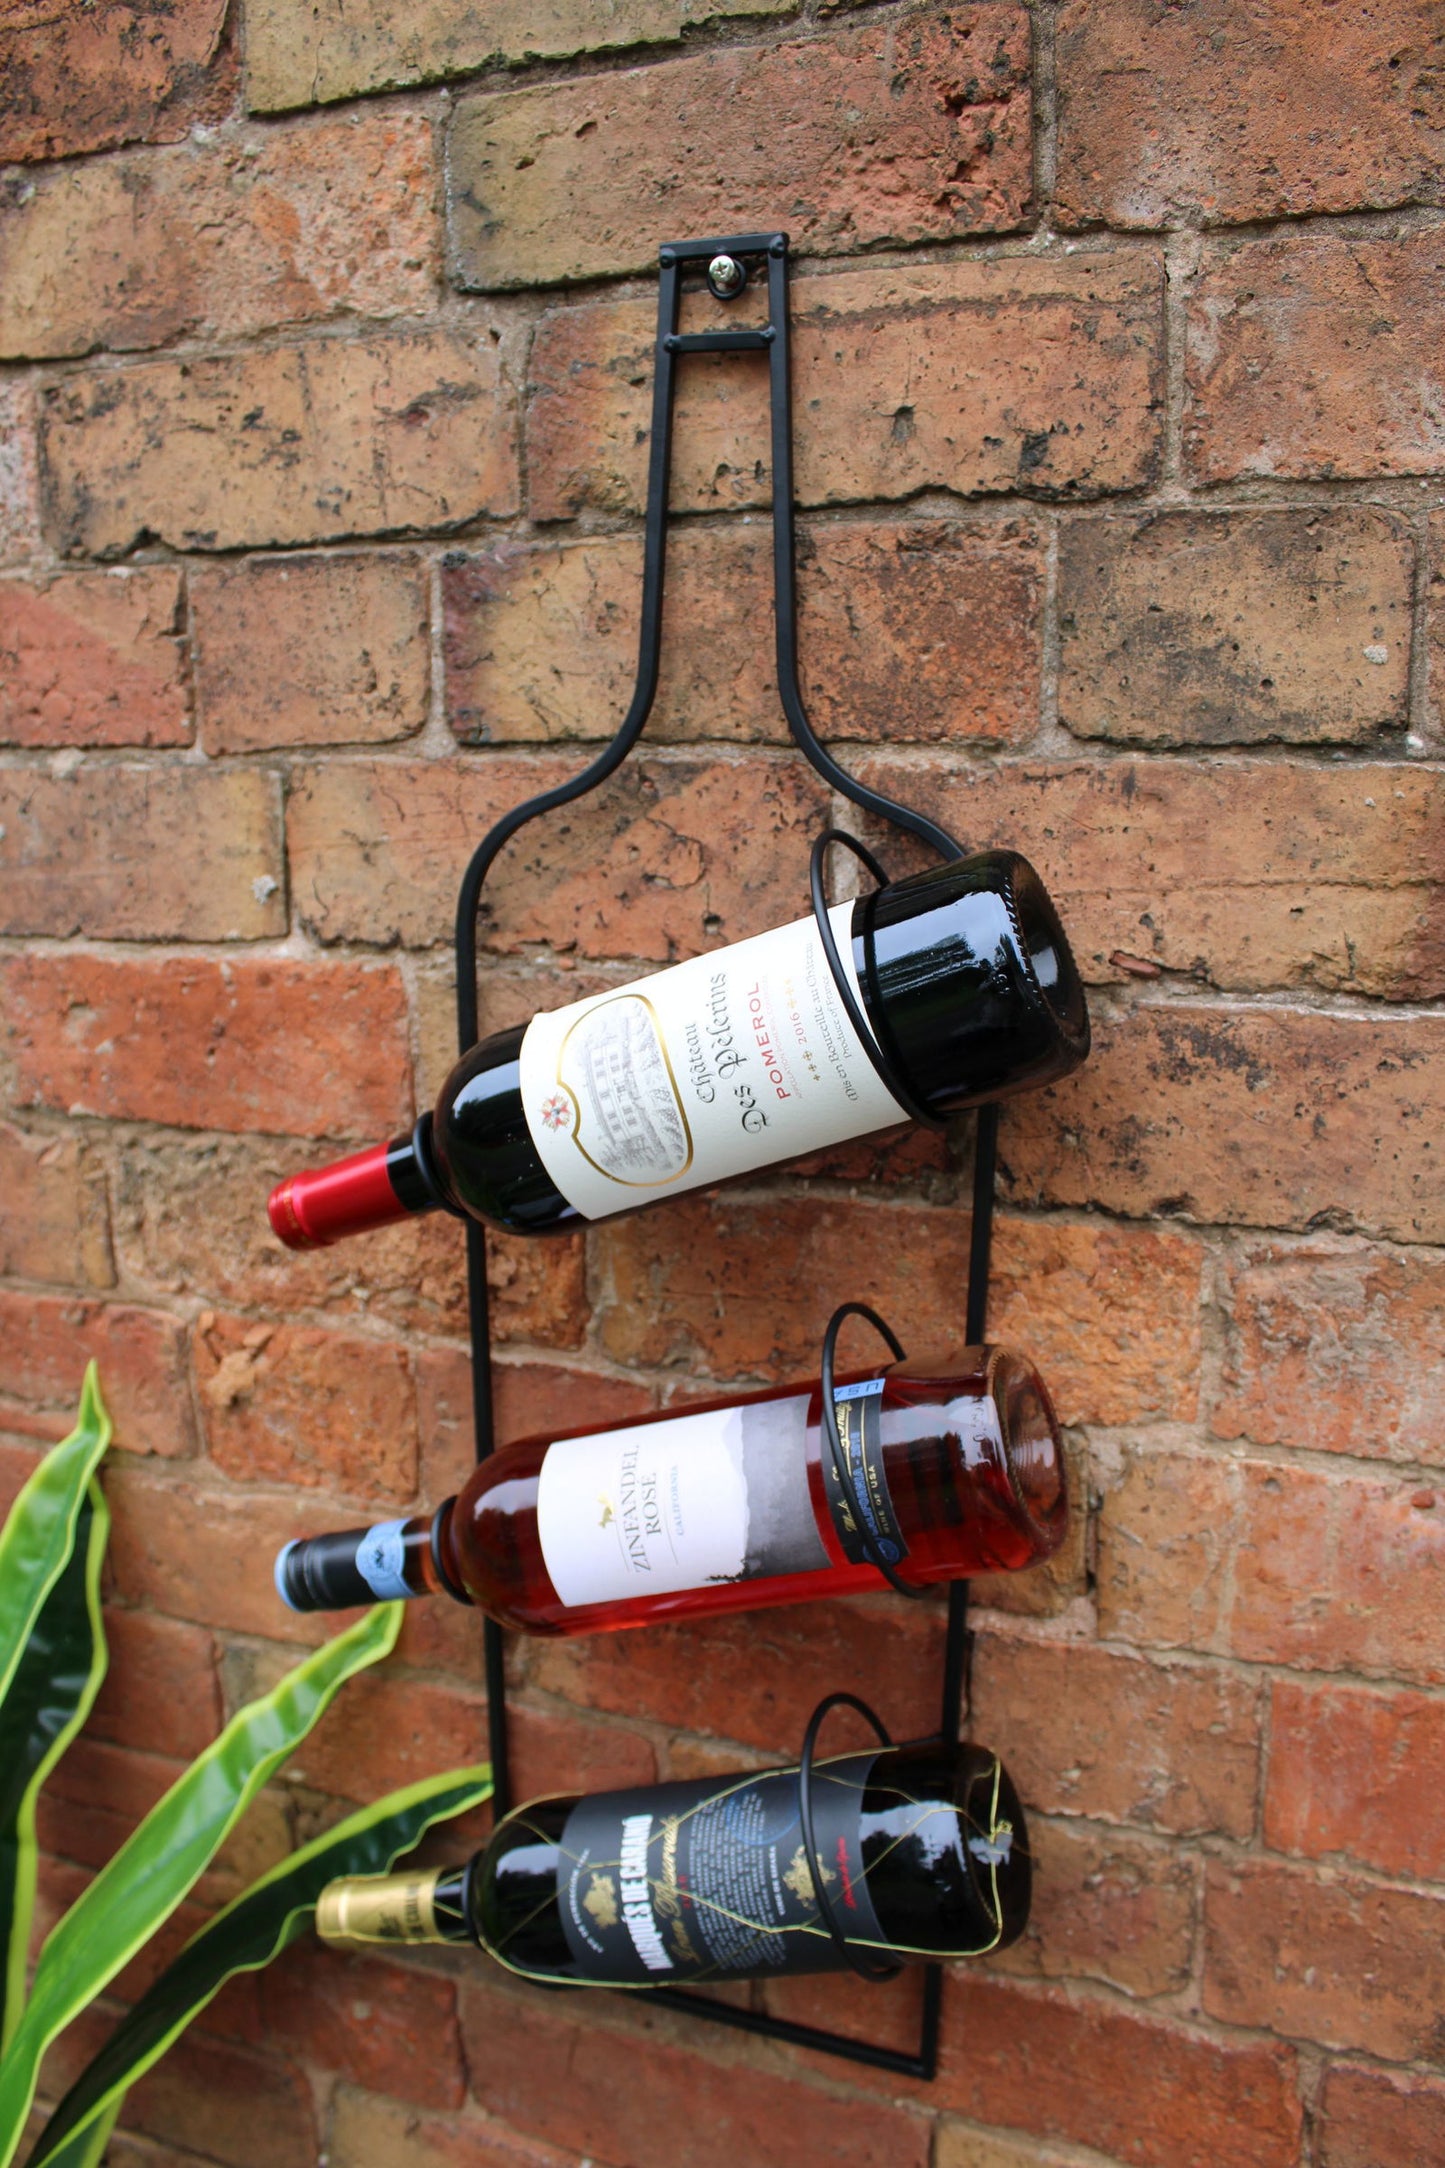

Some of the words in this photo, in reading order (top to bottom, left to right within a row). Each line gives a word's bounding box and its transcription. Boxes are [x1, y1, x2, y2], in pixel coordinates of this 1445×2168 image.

[822, 975, 834, 1006] France
[789, 1012, 808, 1045] 2016
[829, 1007, 839, 1018] of
[747, 982, 791, 1100] POMEROL
[833, 1020, 852, 1060] Produce
[684, 1021, 716, 1104] Château
[835, 1064, 847, 1080] en
[734, 1085, 772, 1134] Des
[867, 1464, 879, 1489] USA
[620, 1444, 652, 1573] ZINFANDEL
[670, 1465, 684, 1536] CALIFORNIA
[620, 1878, 650, 1903] DE
